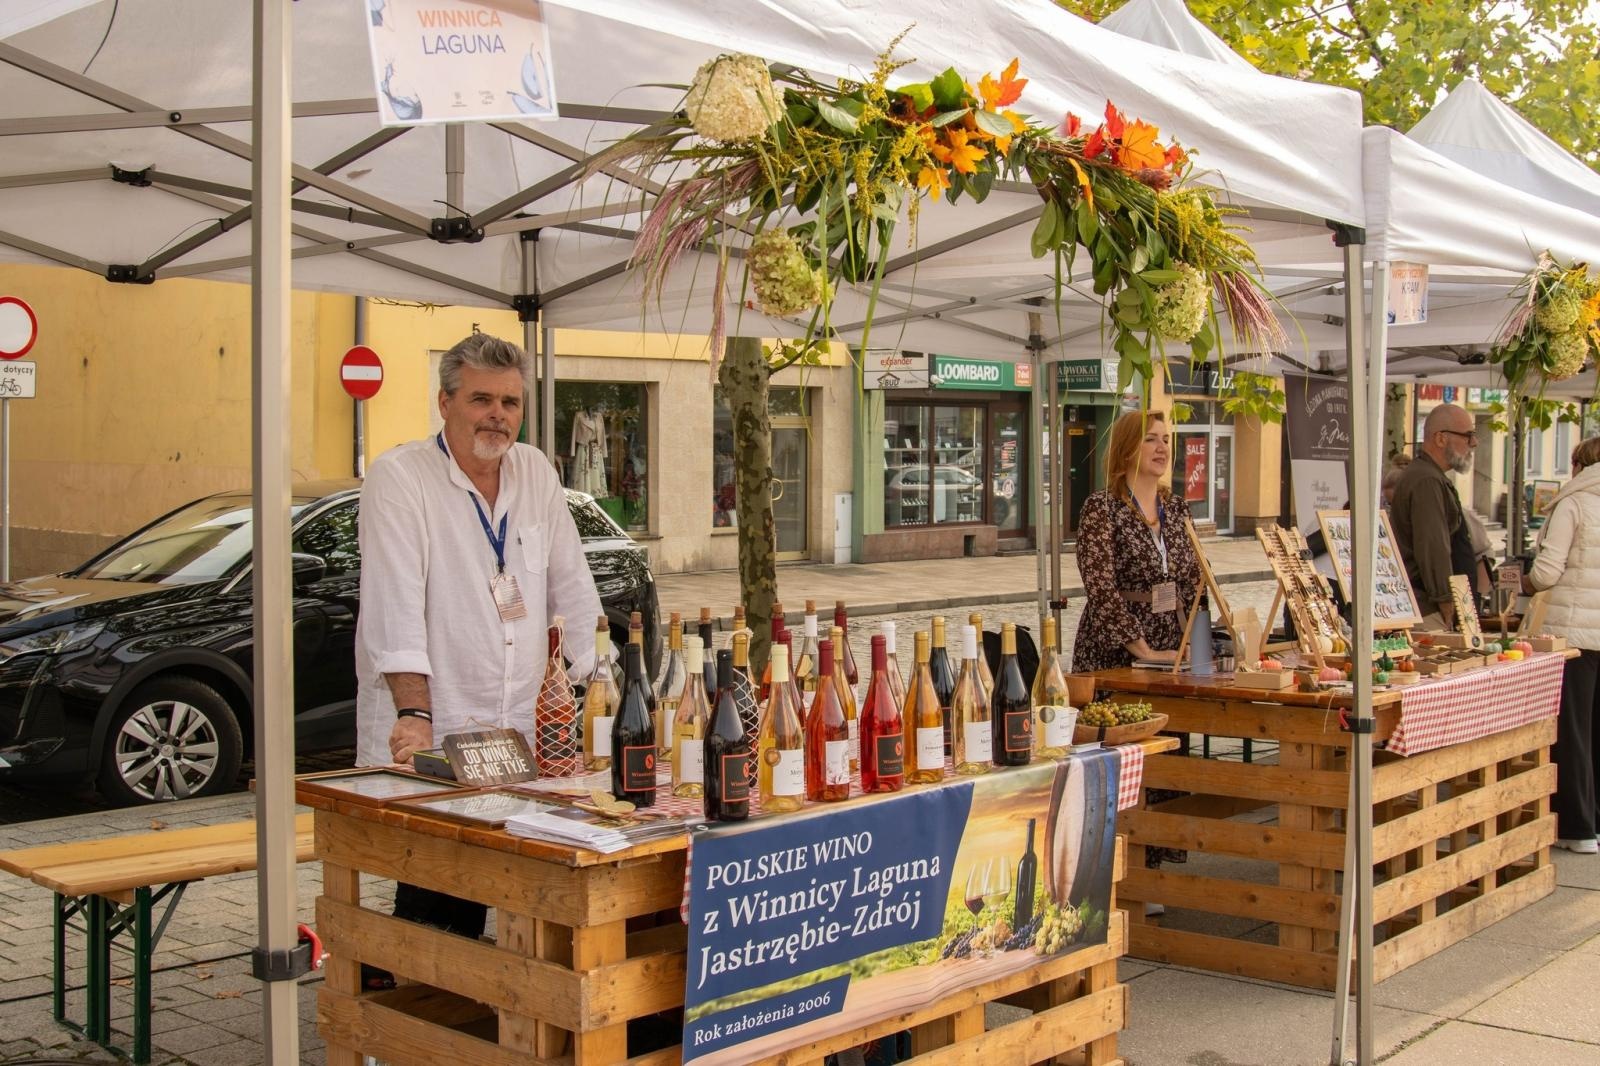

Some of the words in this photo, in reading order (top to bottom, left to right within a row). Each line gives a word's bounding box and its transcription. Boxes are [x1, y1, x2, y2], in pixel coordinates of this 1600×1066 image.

[417, 9, 503, 28] WINNICA
[421, 34, 507, 55] LAGUNA
[3, 364, 34, 376] dotyczy
[938, 363, 999, 381] LOOMBARD
[1058, 364, 1099, 376] ADWOKAT
[1186, 444, 1206, 456] SALE
[1187, 460, 1206, 493] -70%
[463, 749, 481, 765] OD
[481, 745, 513, 763] WINA
[463, 764, 486, 781] SIĘ
[482, 761, 505, 778] NIE
[502, 759, 530, 775] TYJE
[706, 847, 809, 891] POLSKIE
[812, 830, 874, 867] WINO
[702, 910, 720, 935] z
[727, 877, 848, 929] Winnicy
[851, 854, 941, 898] Laguna
[696, 890, 922, 990] Jastrzębie-Zdrój
[693, 1024, 723, 1047] Rok
[724, 1004, 796, 1037] założenia
[797, 991, 832, 1015] 2006
